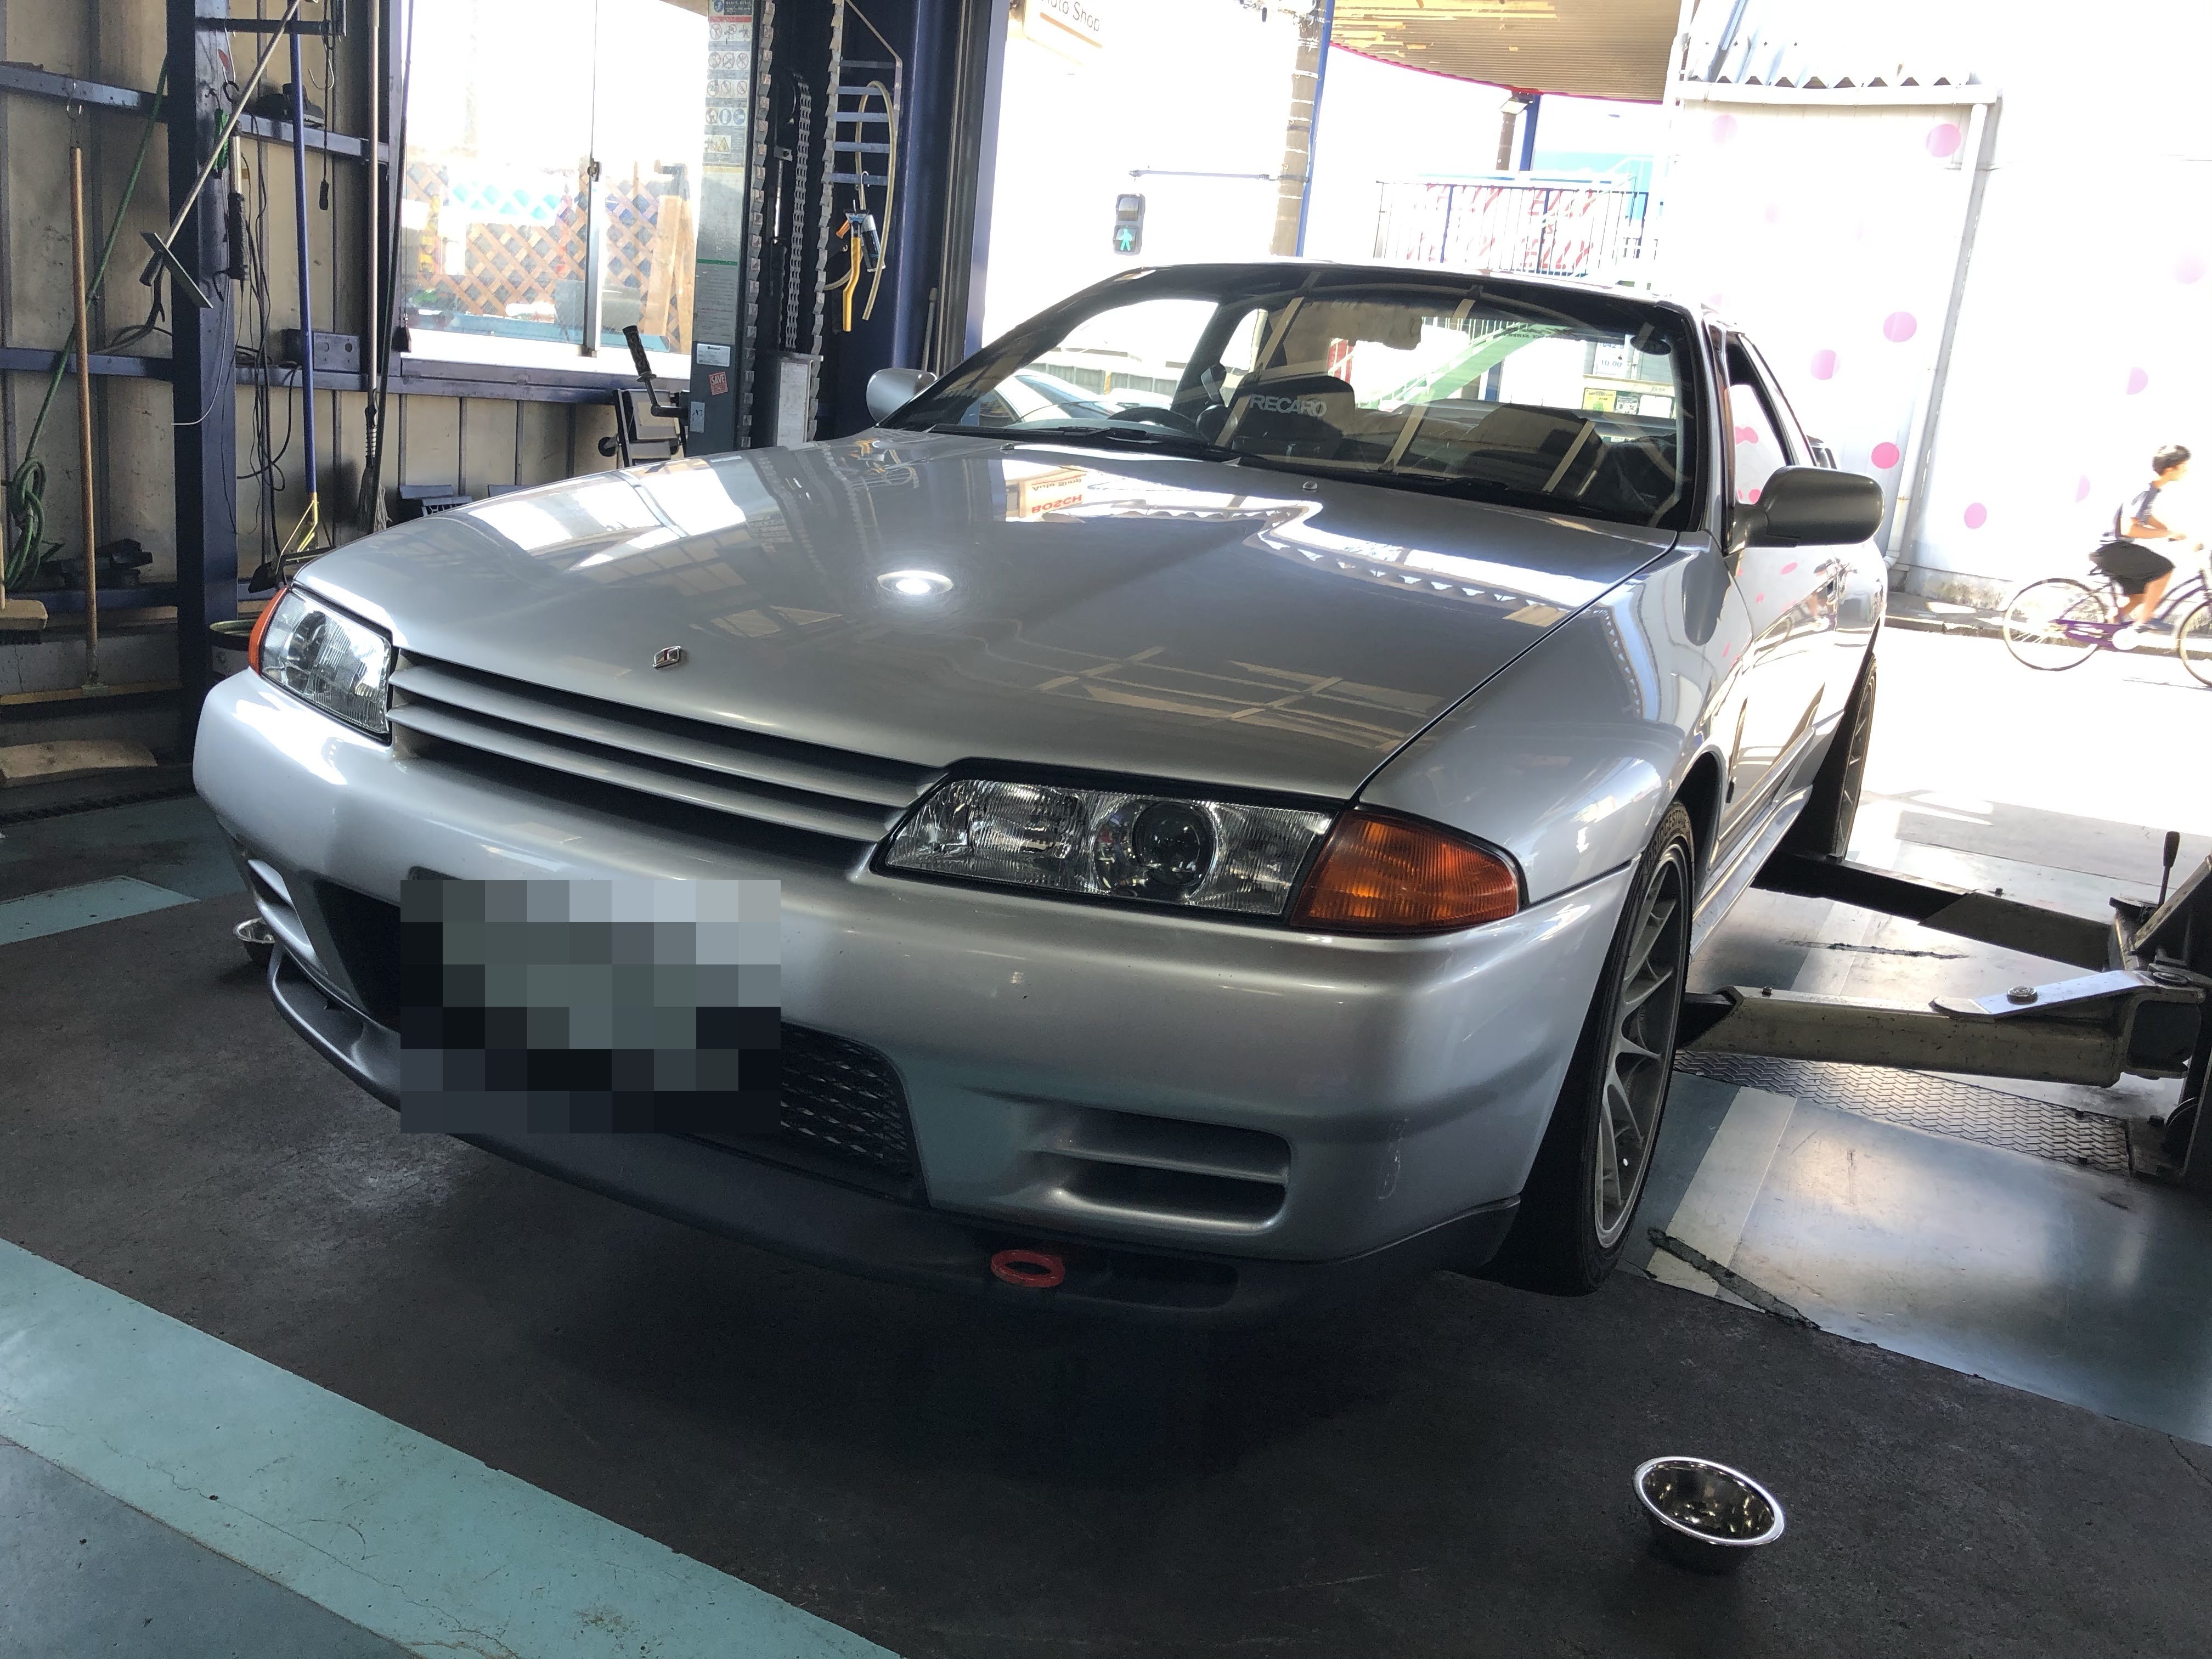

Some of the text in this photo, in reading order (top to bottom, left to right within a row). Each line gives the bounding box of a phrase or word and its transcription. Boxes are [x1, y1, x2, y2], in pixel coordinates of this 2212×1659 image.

[1042, 0, 1101, 31] uto Shop
[711, 374, 725, 385] SAVE
[1249, 394, 1328, 417] RECARO
